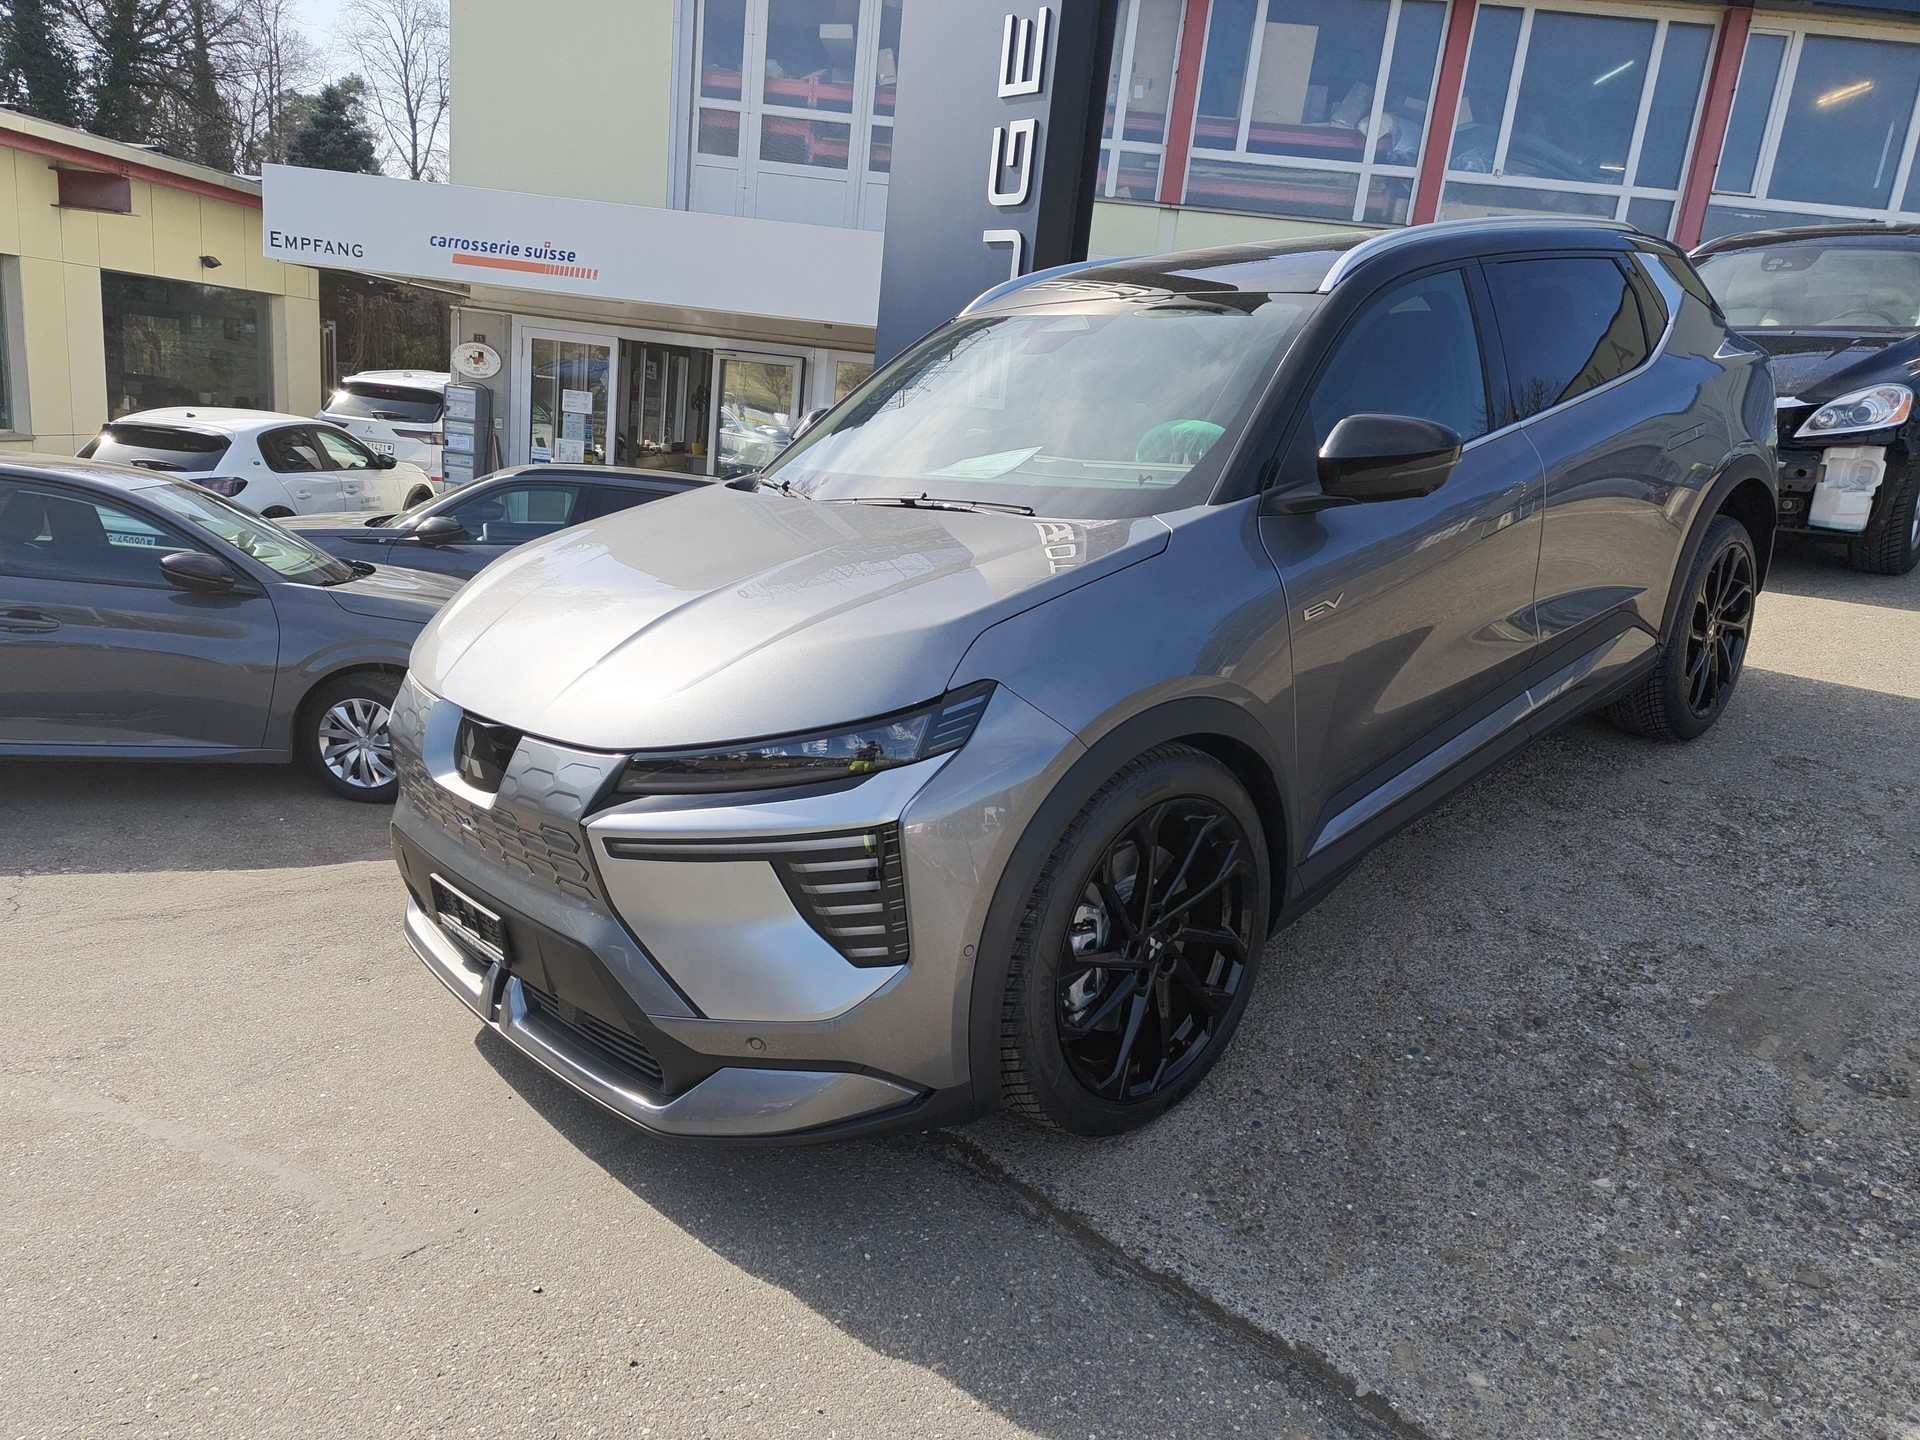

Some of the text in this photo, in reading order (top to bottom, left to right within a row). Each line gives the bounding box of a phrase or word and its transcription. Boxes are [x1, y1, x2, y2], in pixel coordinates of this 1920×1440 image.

[270, 230, 364, 258] EMPFANG
[429, 235, 576, 262] carrosserie suisse
[1303, 592, 1344, 621] EV
